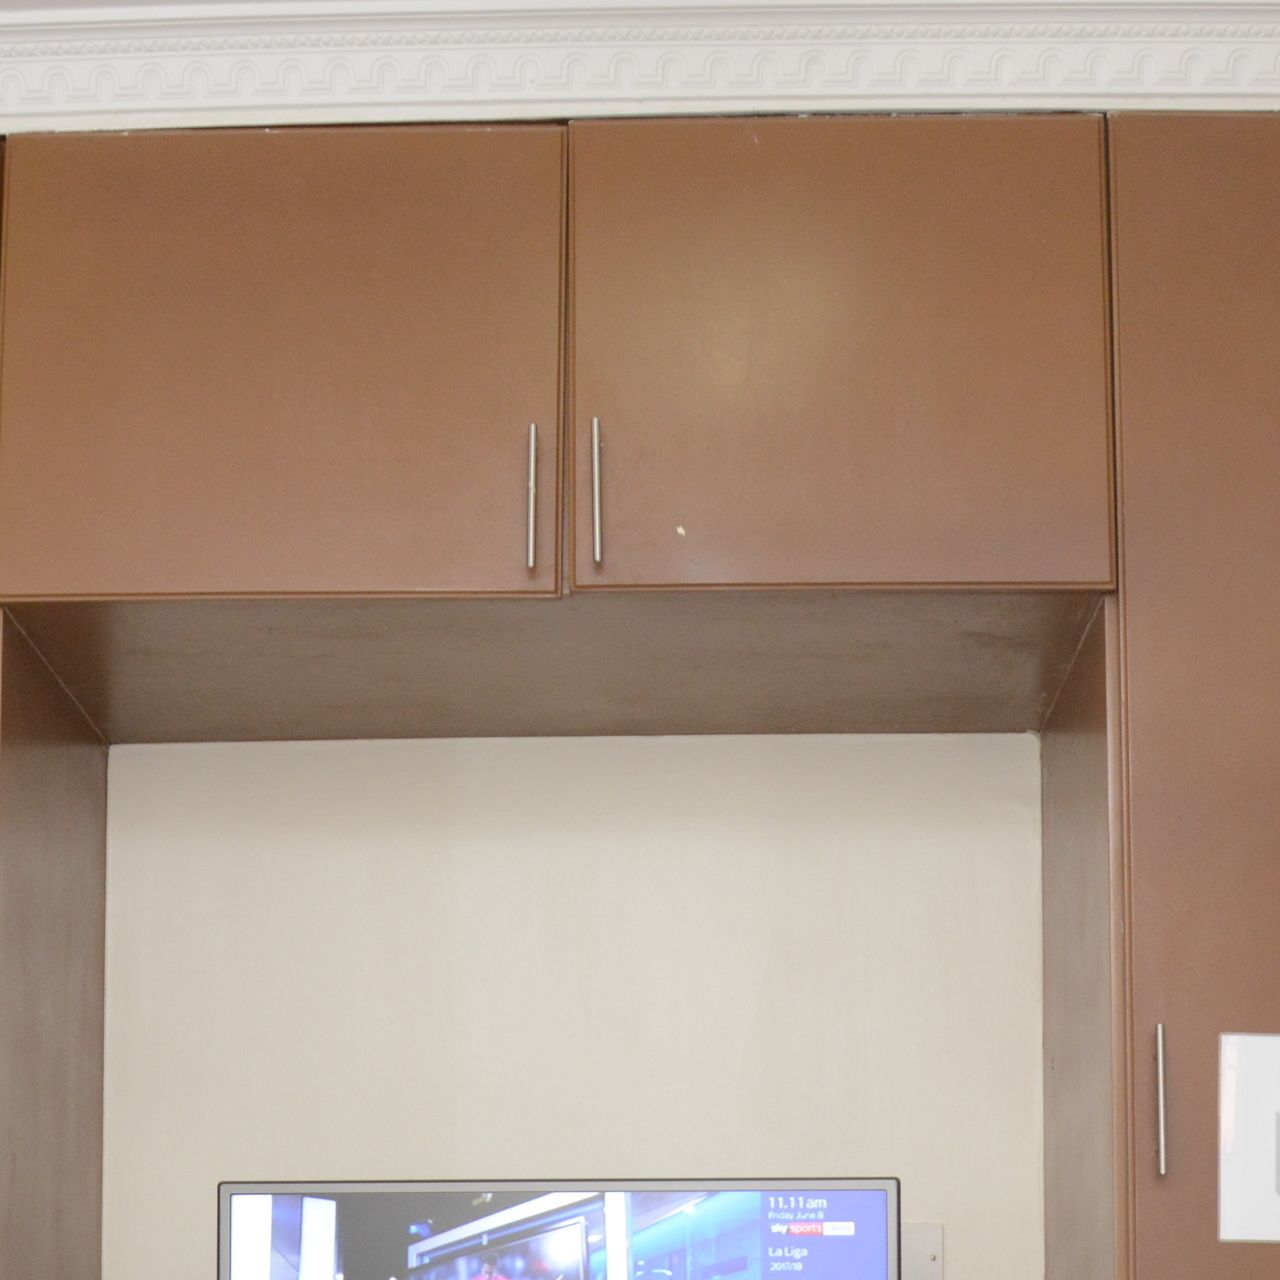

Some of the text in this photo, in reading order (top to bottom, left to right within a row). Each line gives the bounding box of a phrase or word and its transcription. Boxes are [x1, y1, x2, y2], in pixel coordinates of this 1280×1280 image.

[795, 1211, 816, 1220] June
[770, 1222, 788, 1235] sky
[768, 1247, 808, 1259] La Liga
